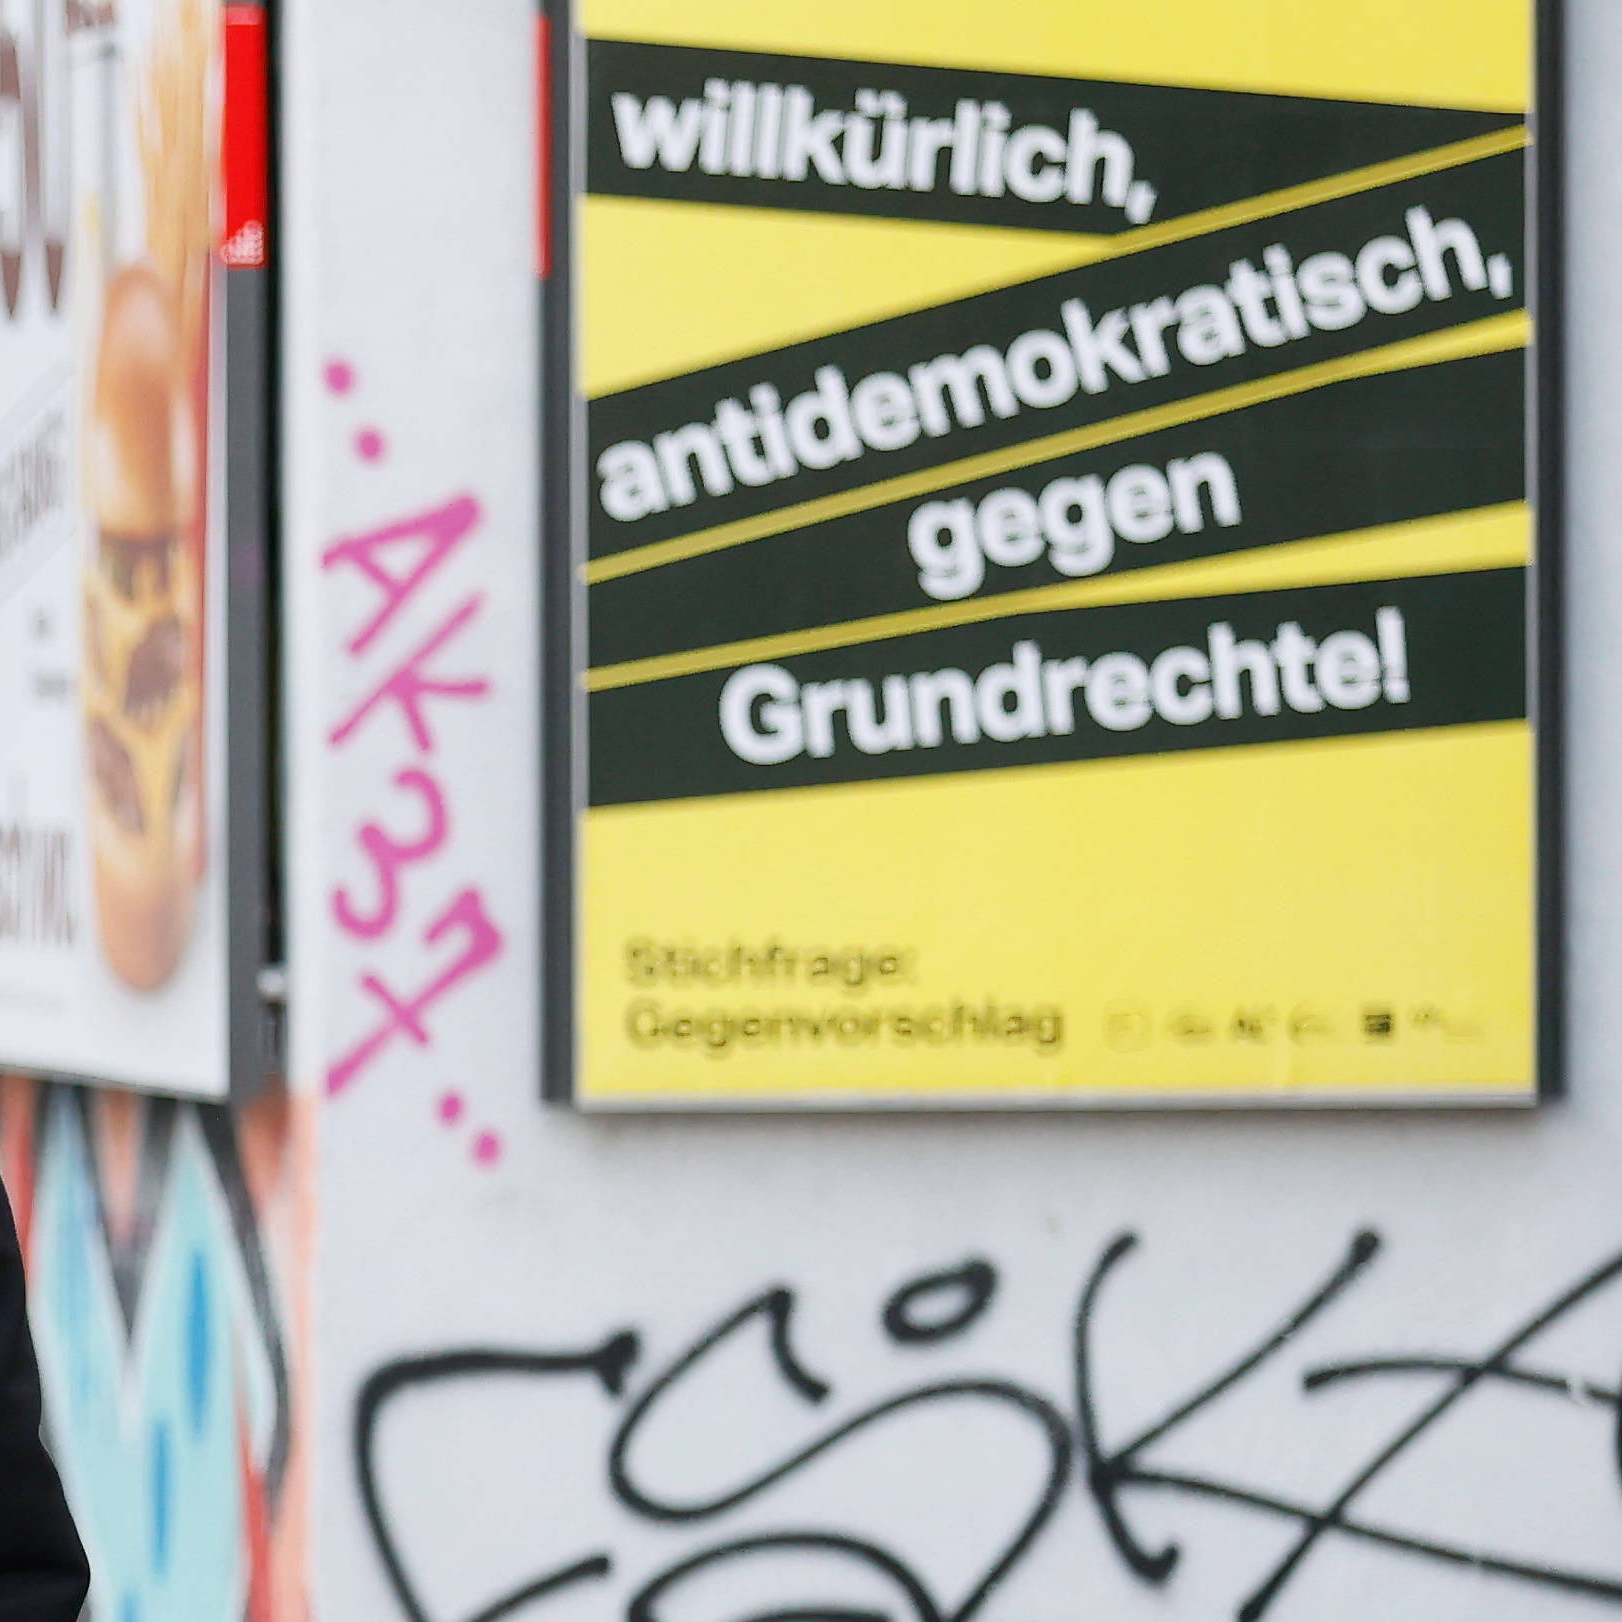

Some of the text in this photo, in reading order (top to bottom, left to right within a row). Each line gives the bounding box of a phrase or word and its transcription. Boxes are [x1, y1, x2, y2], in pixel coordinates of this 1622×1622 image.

[612, 78, 1157, 226] willkürlich,
[595, 204, 1513, 524] antidemokratisch,
[906, 450, 1241, 600] gegen
[718, 606, 1411, 765] Grundrechte!
[625, 936, 918, 994] Stichfrage:
[625, 996, 1064, 1060] Gegenvorschlag
